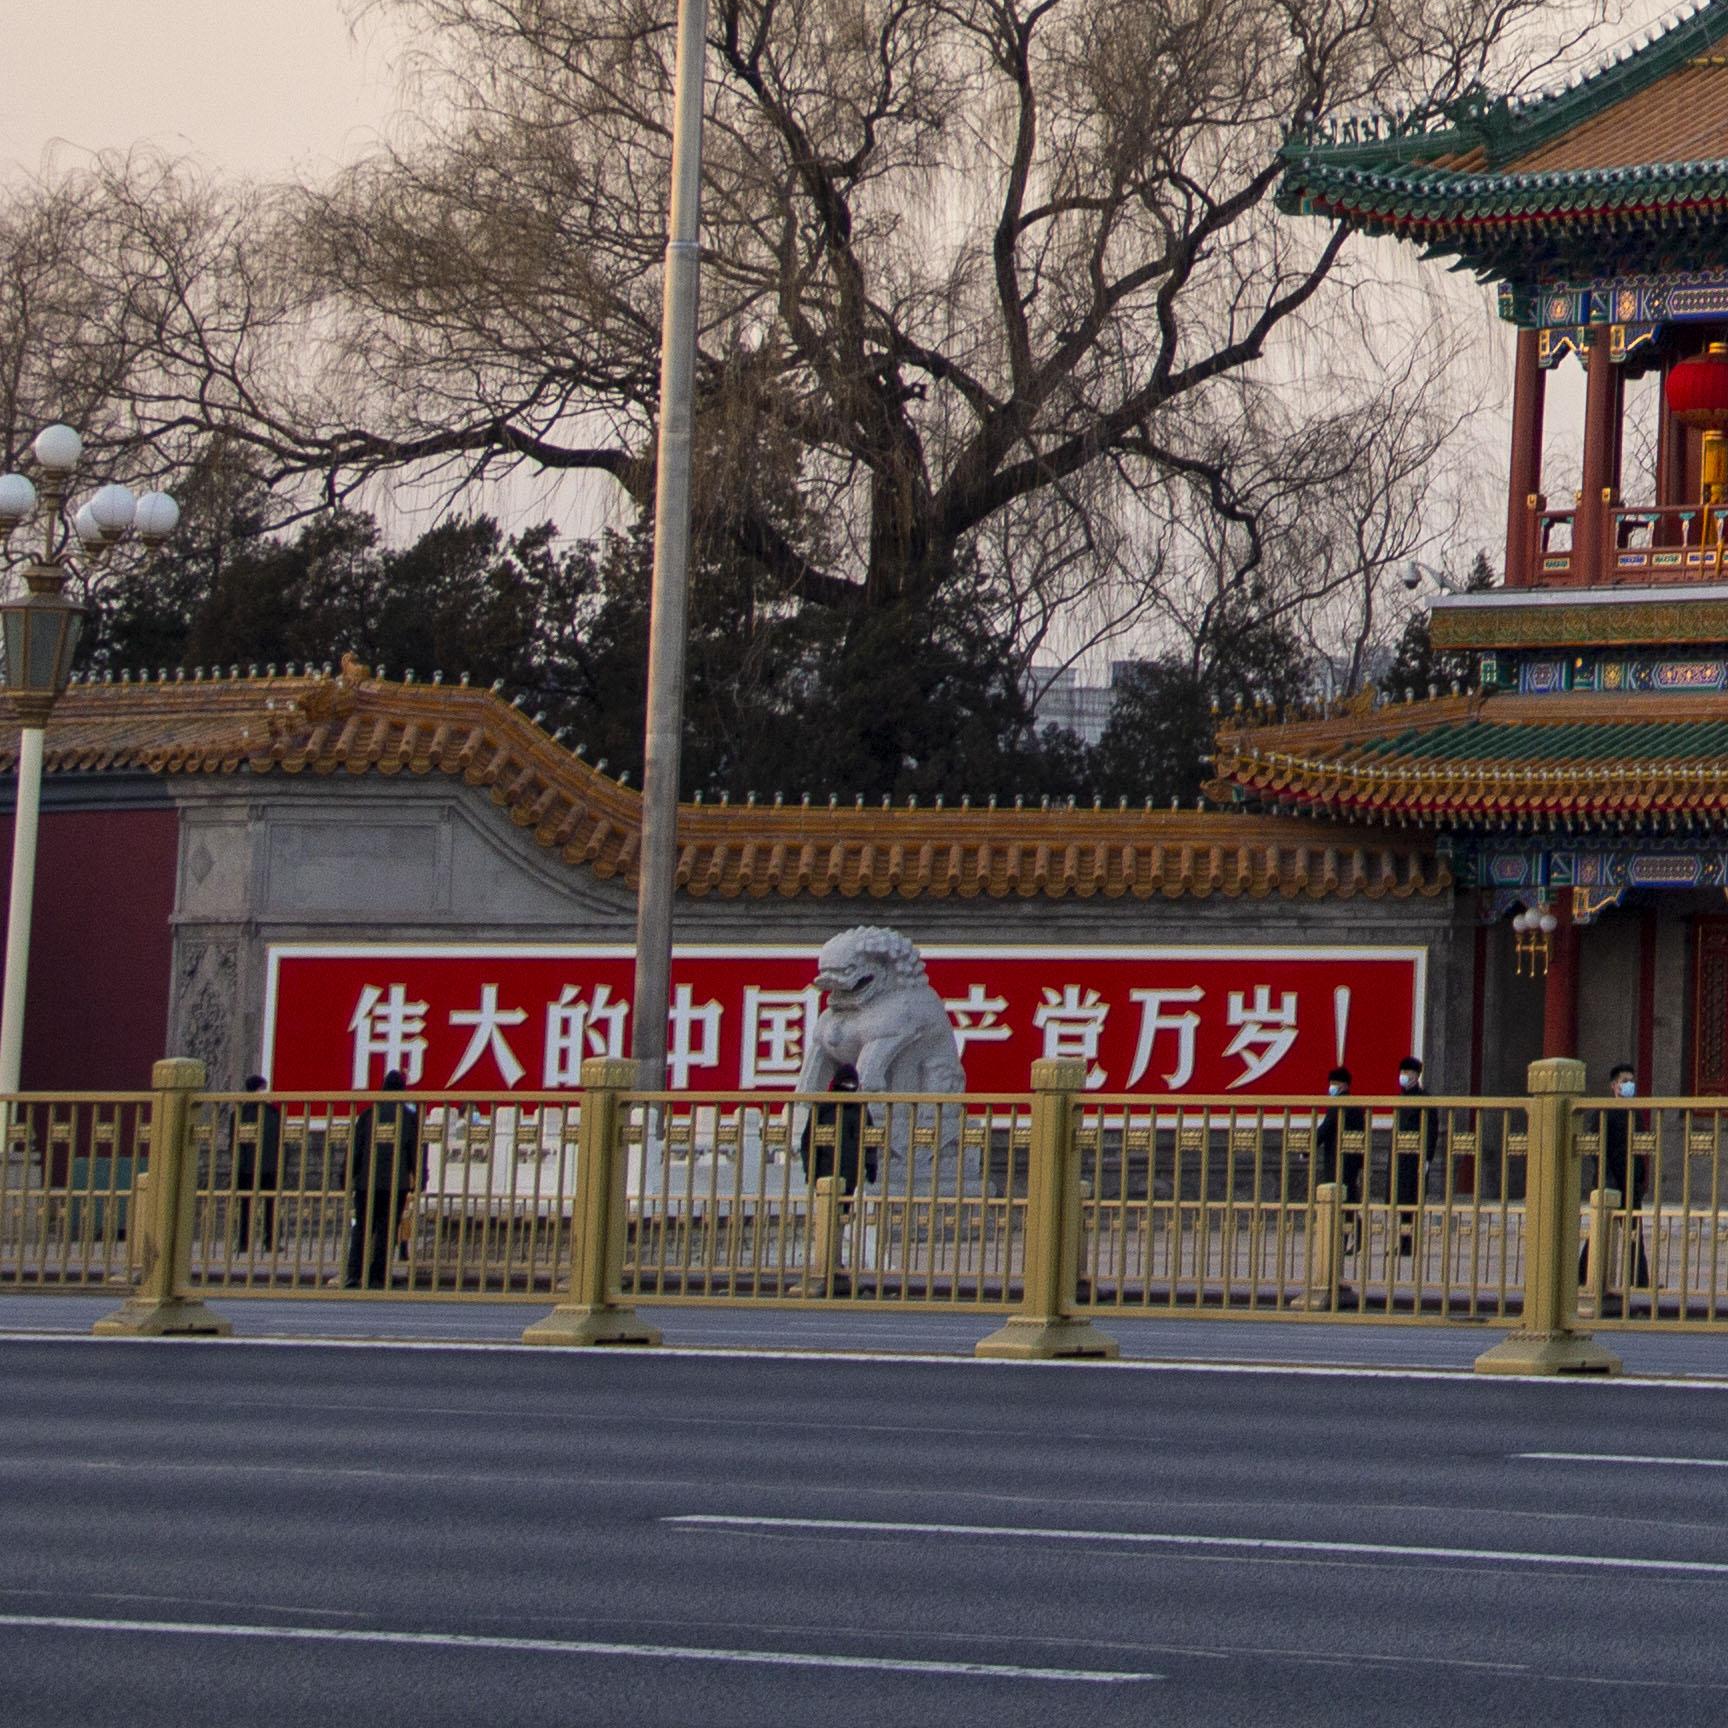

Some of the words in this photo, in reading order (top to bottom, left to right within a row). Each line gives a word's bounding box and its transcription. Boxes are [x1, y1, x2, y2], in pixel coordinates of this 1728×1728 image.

[348, 982, 1351, 1091] 伟大的中国产党万岁！
